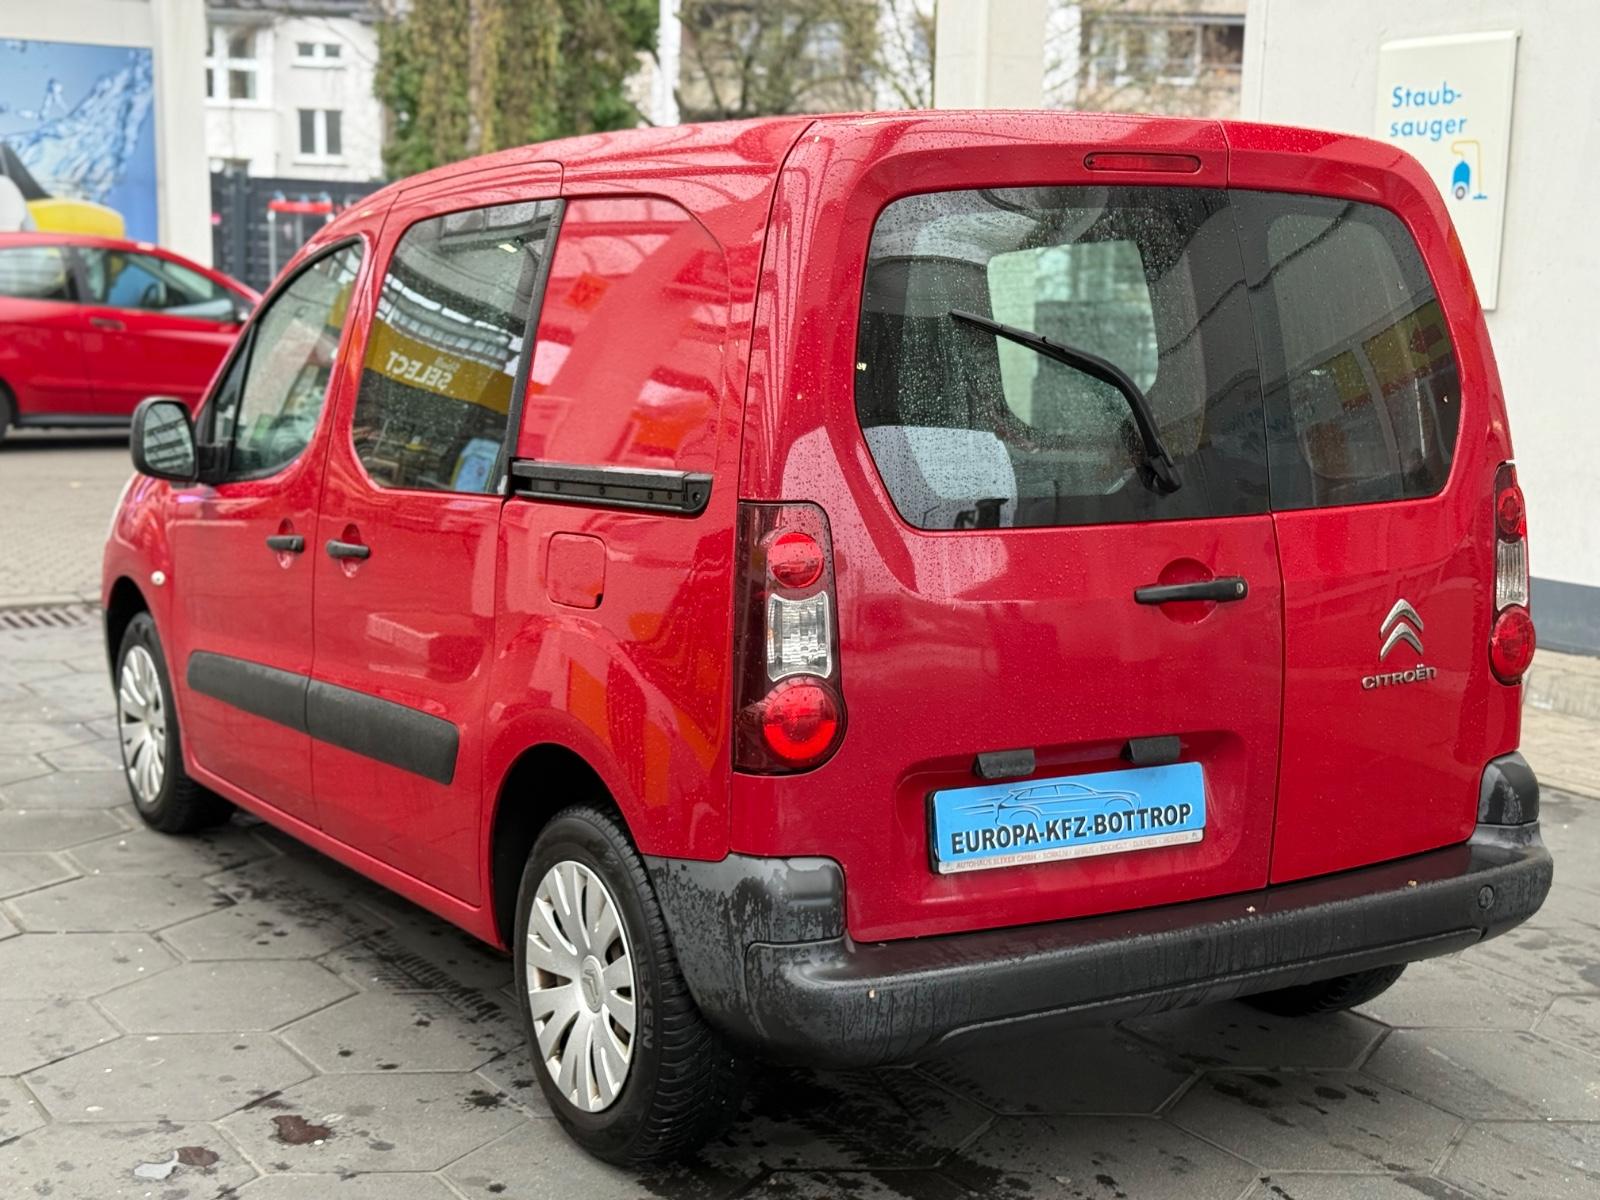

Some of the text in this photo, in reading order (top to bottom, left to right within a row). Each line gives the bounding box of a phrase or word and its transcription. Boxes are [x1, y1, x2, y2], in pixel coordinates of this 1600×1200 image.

[1392, 81, 1462, 108] Staub-
[1390, 118, 1467, 142] sauger
[951, 803, 1192, 855] EUROPA-KFZ-BOTTROP
